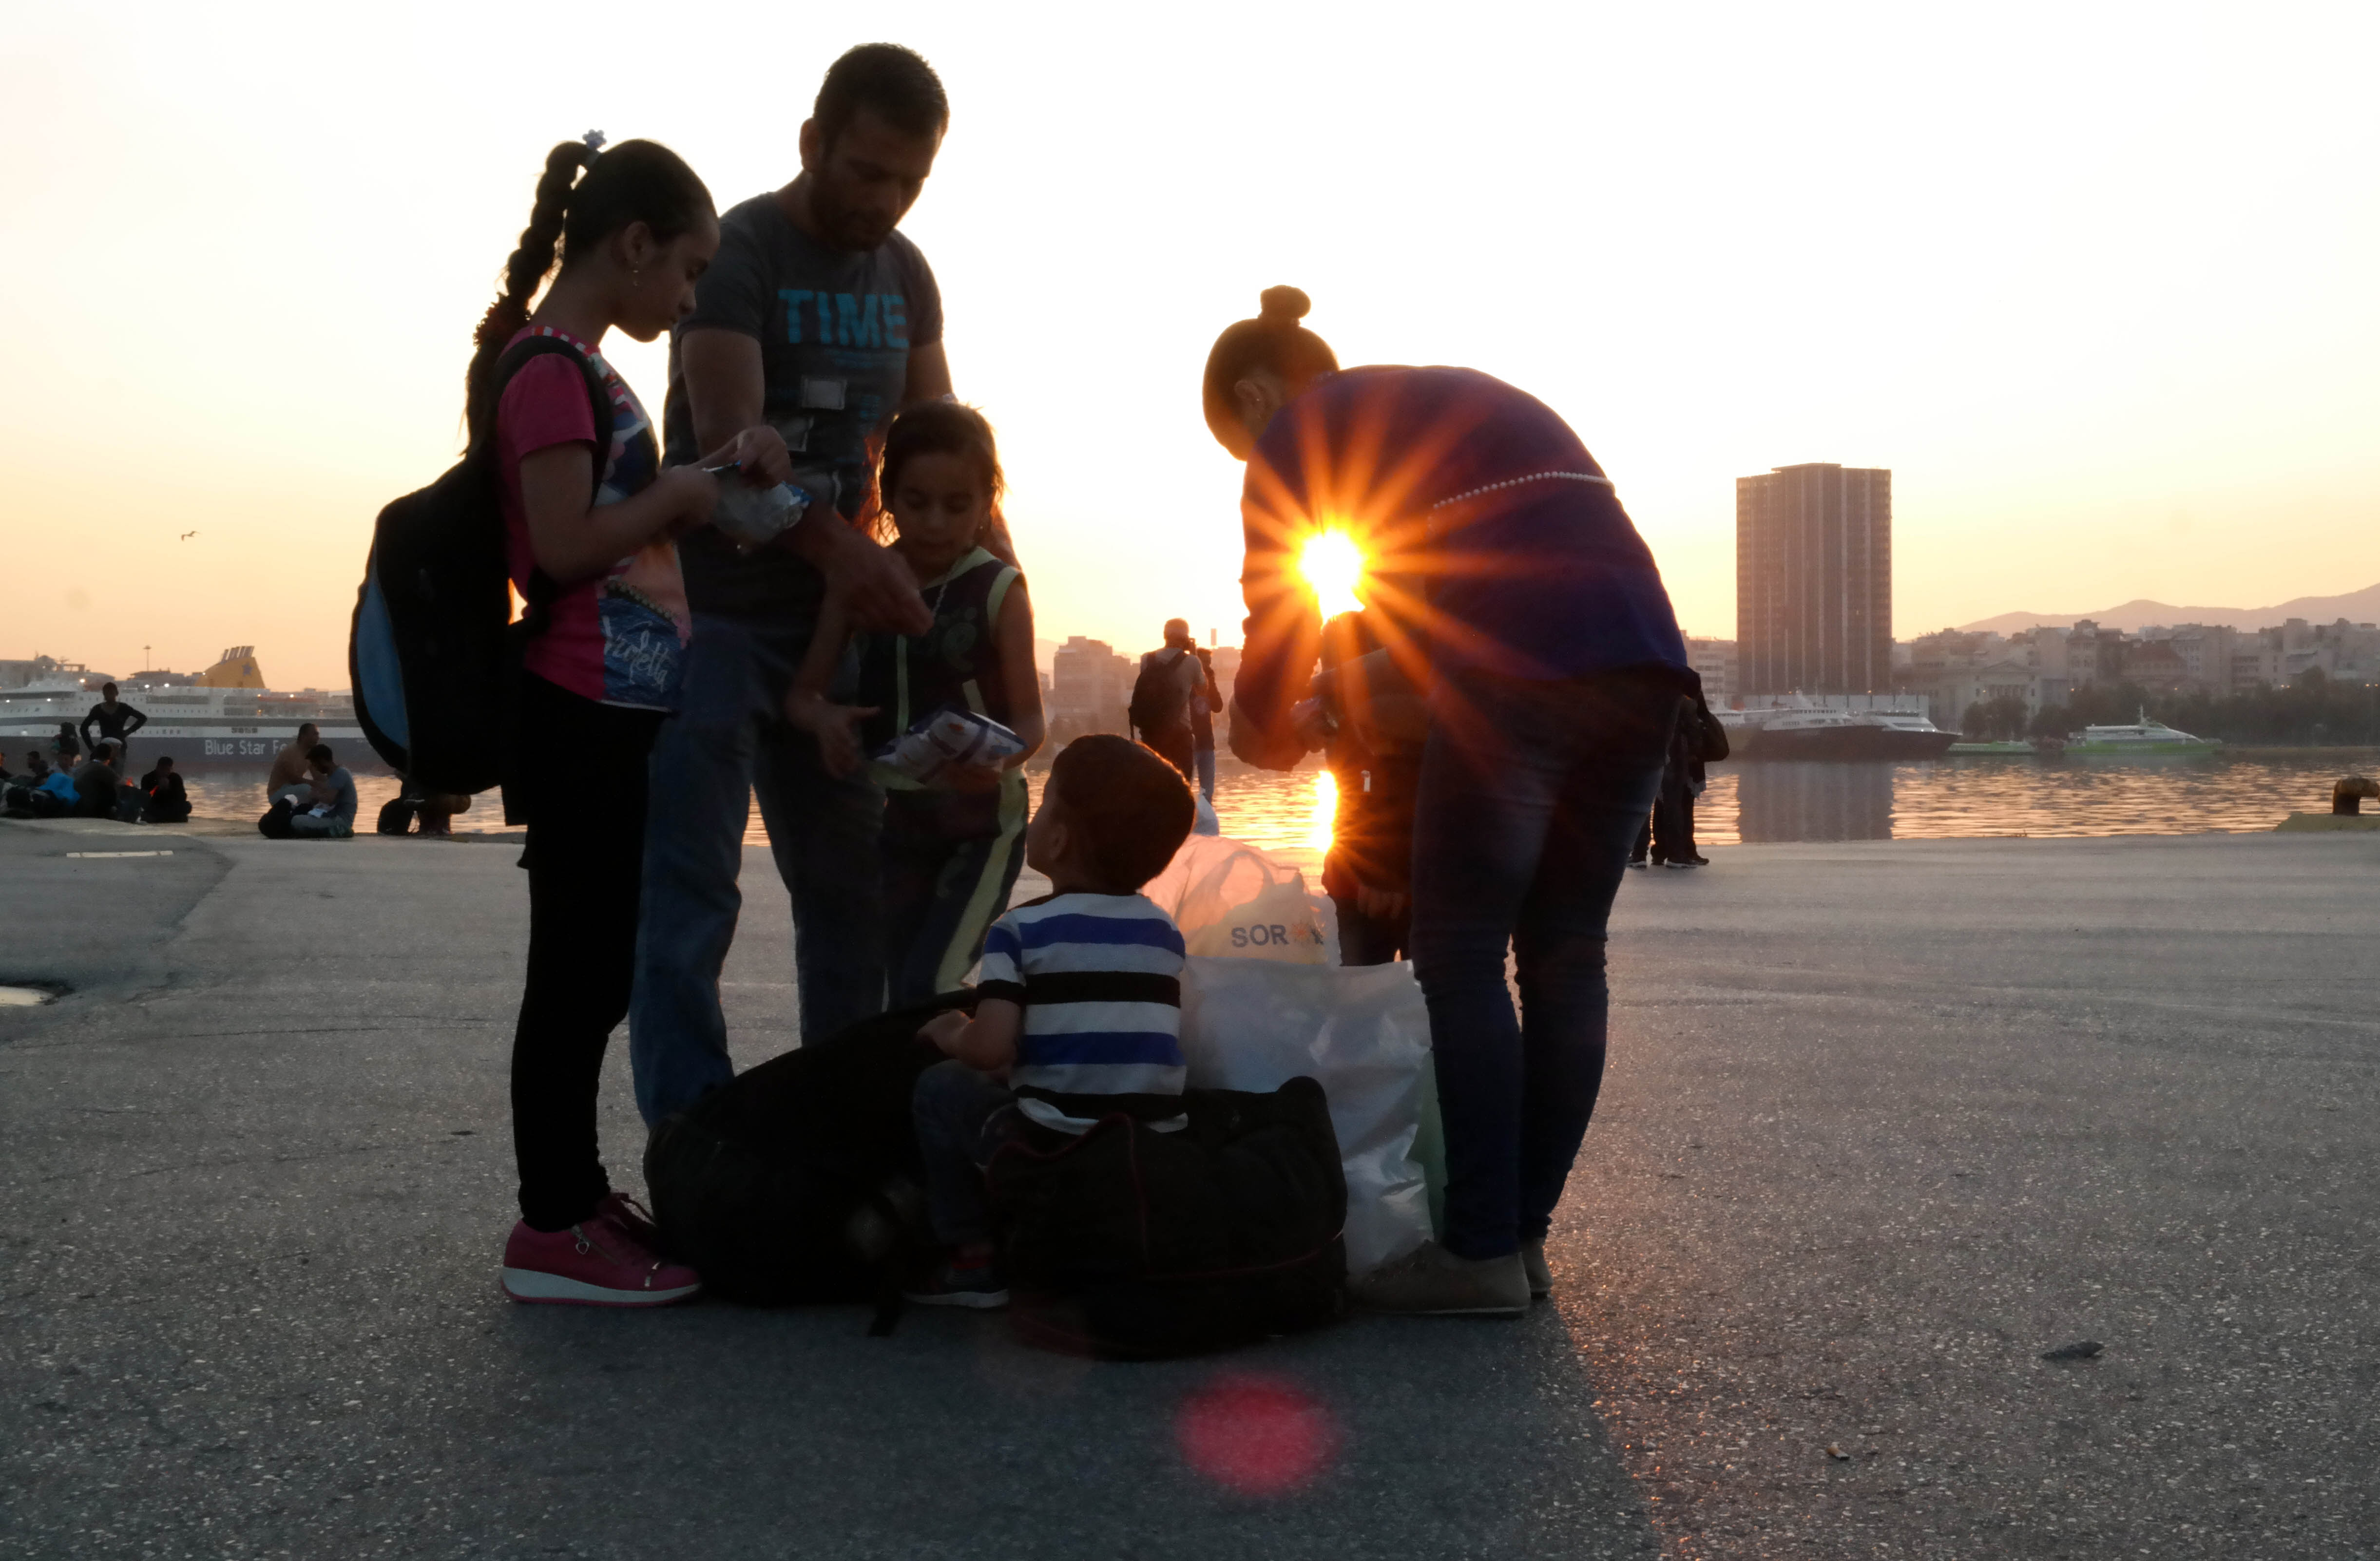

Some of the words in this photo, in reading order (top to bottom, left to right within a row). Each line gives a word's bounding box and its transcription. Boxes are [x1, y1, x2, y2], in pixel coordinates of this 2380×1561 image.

[777, 289, 910, 348] TIME
[205, 740, 233, 755] Blue
[239, 740, 266, 755] Star
